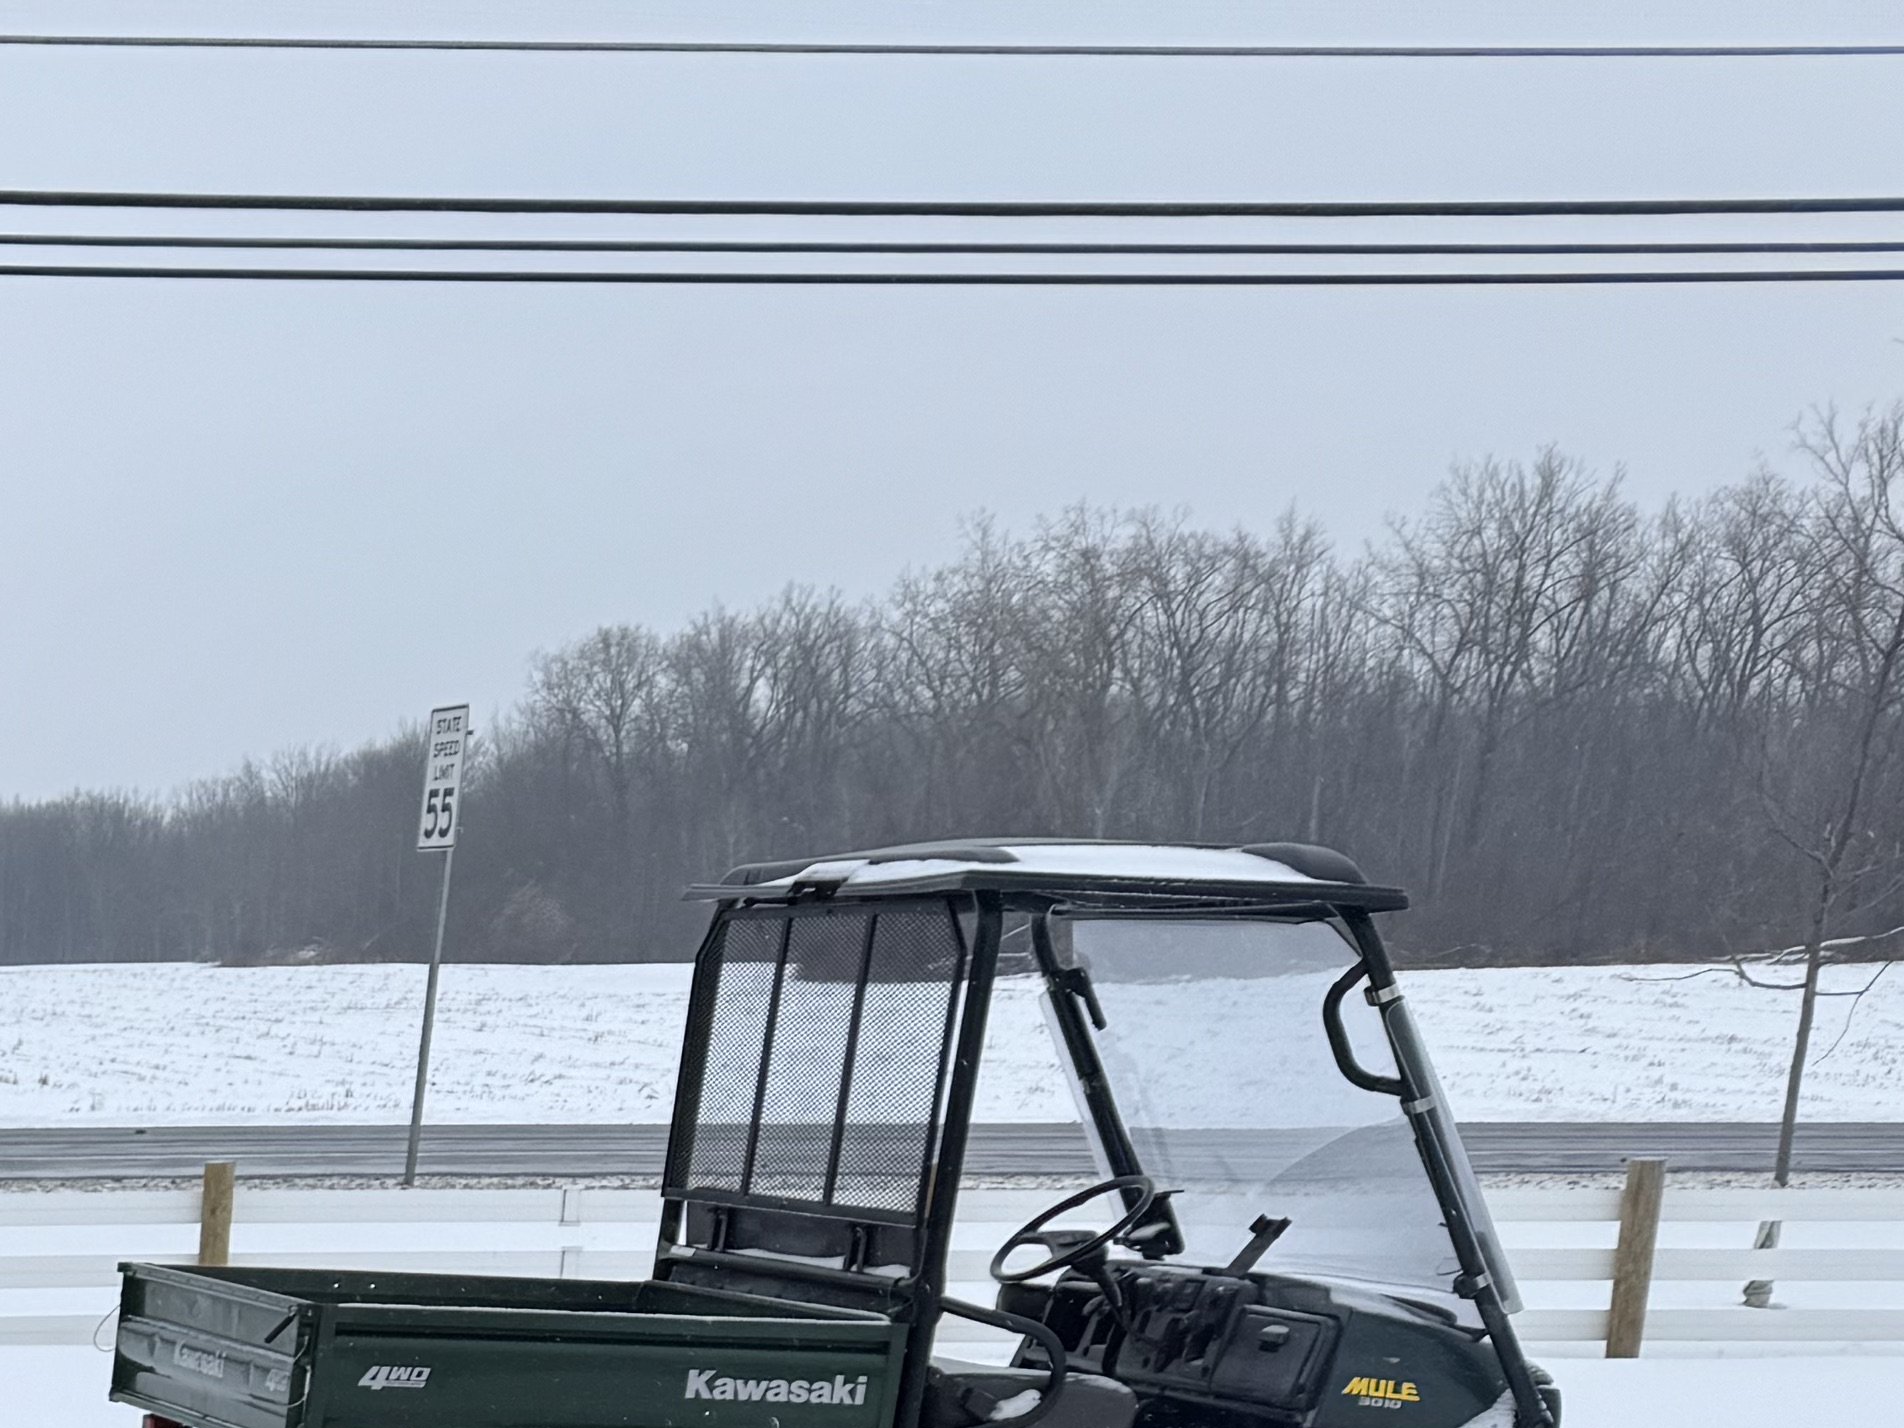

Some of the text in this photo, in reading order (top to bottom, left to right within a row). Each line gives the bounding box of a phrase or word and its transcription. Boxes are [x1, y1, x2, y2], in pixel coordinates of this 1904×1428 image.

[436, 716, 462, 735] STATE
[433, 740, 460, 758] SPEED
[433, 763, 455, 781] LIMIT
[424, 787, 455, 839] 55
[357, 1365, 432, 1391] 4WD
[684, 1368, 869, 1406] Kawasaki
[1341, 1376, 1421, 1402] MULE
[1357, 1396, 1403, 1410] 3010
